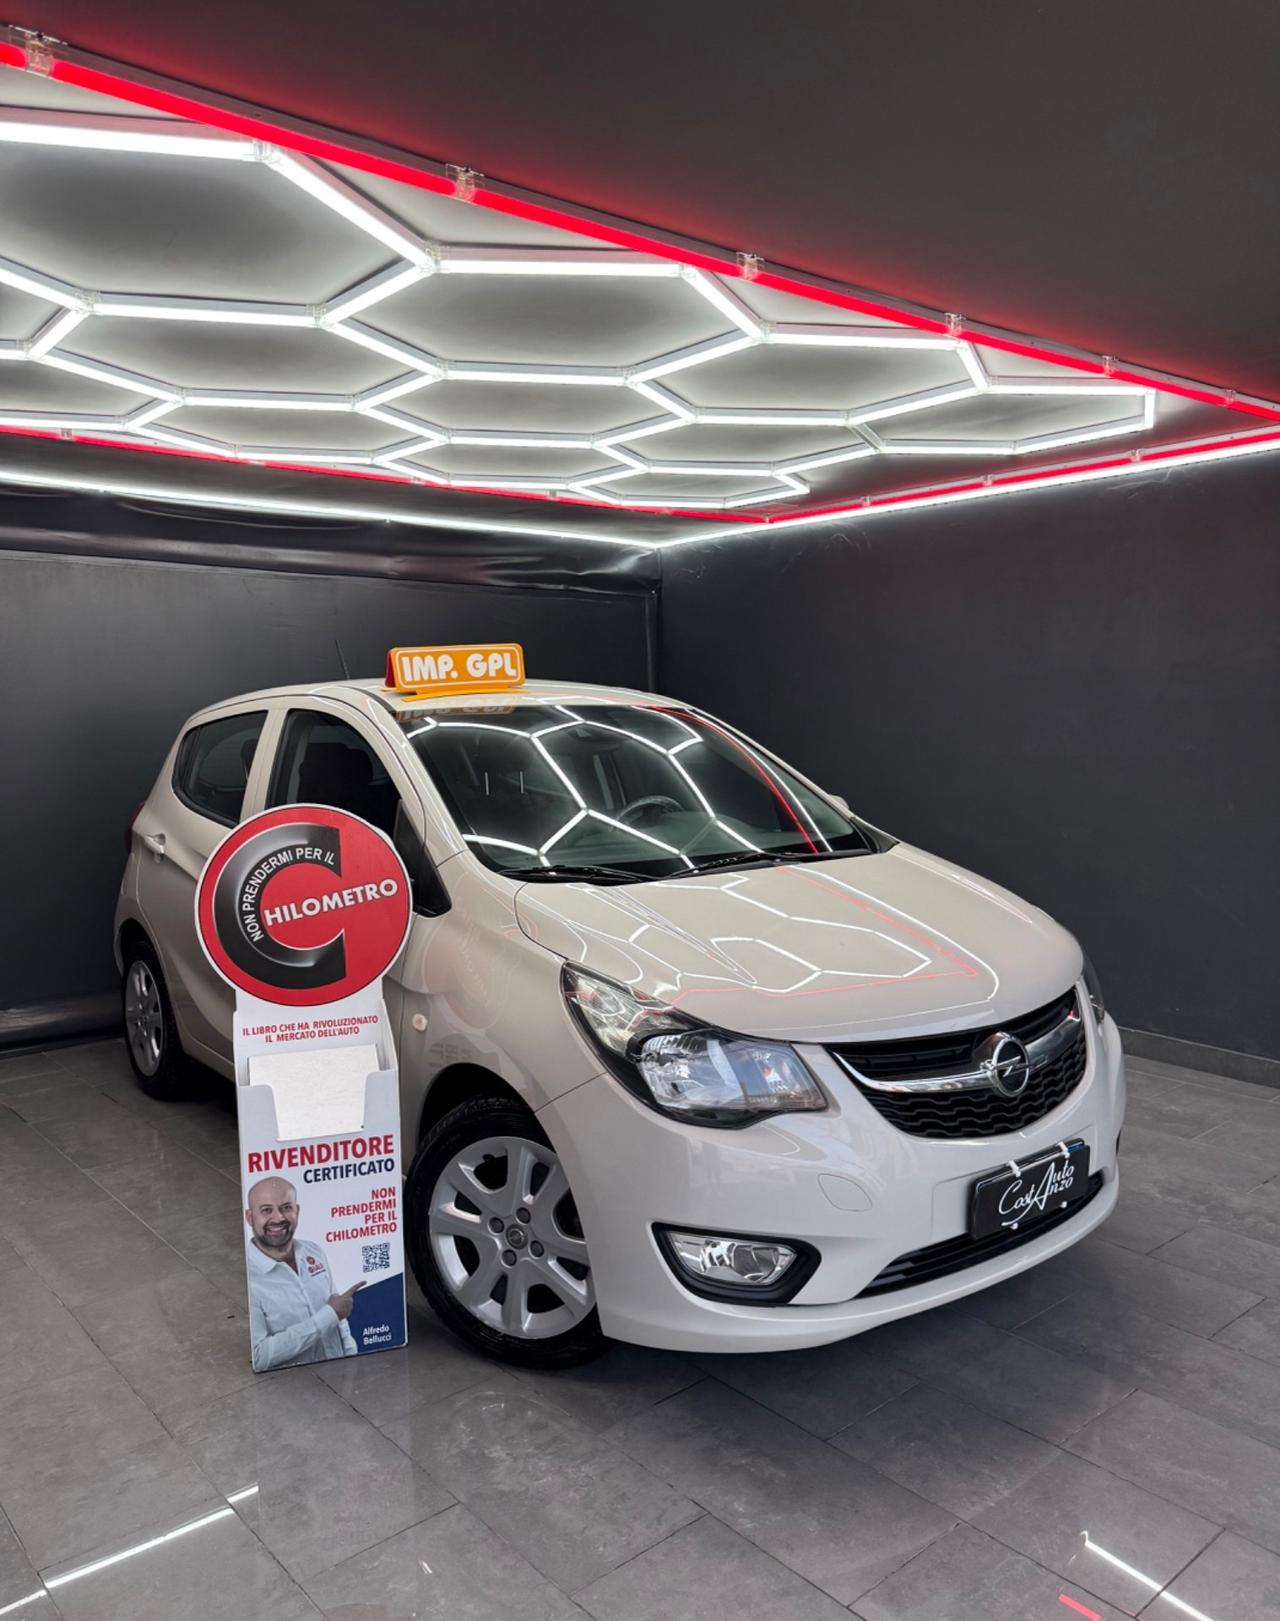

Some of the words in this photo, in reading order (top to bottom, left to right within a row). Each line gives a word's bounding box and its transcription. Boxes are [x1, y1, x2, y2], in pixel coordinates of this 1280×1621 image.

[402, 654, 458, 682] IMP.
[466, 652, 517, 678] GPL
[296, 847, 322, 861] PER
[324, 851, 335, 866] IL
[242, 849, 294, 911] PRENDERMI
[244, 914, 265, 943] NON
[242, 1027, 251, 1036] IL
[252, 1025, 277, 1035] LIBRO
[279, 1023, 296, 1032] CHE
[297, 1022, 310, 1031] HA
[313, 1015, 378, 1029] RIVOLUZIONATO
[265, 1034, 273, 1043] IL
[276, 1029, 316, 1042] MERCATO
[318, 1026, 360, 1038] DELL'AUTO
[248, 1134, 395, 1173] RIVENDITORE
[303, 1158, 395, 1184] CERTIFICATO
[371, 1186, 396, 1200] NON
[331, 1198, 397, 1218] PRENDERMI
[364, 1212, 386, 1225] PER
[387, 1210, 398, 1221] IL
[326, 1222, 398, 1243] CHILOMETRO
[362, 1324, 390, 1336] Alfredo
[363, 1334, 392, 1345] Bellucci
